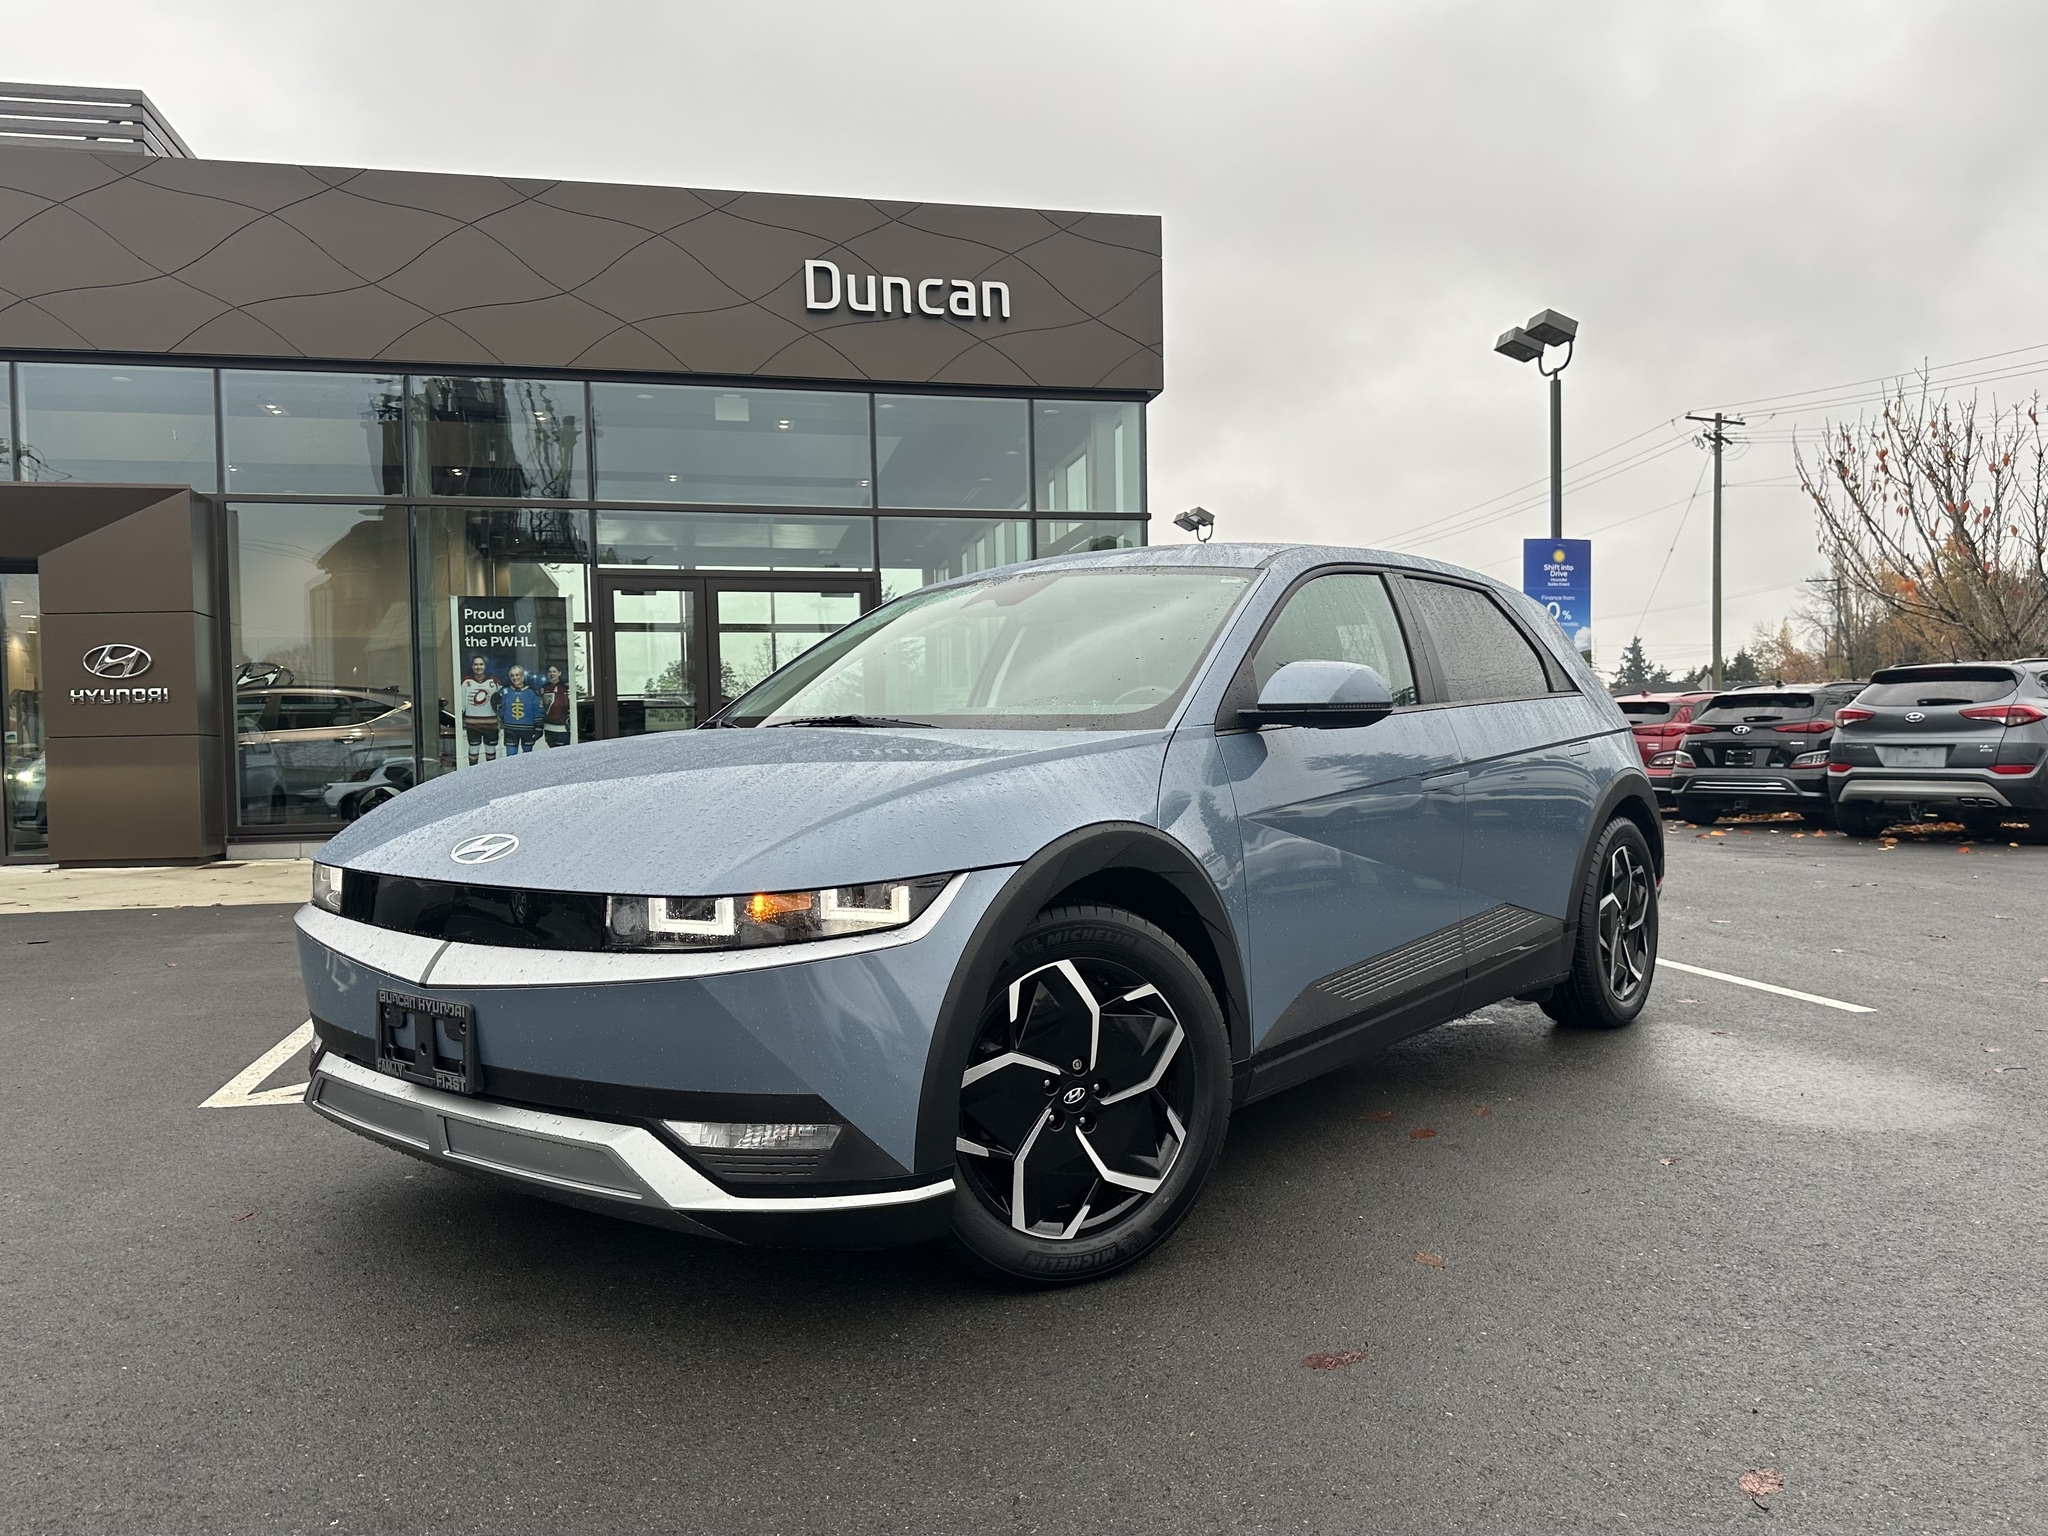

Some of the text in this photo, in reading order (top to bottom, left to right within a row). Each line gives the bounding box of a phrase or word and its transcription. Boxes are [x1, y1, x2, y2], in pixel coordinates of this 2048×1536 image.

[804, 259, 1011, 318] Duncan
[464, 608, 505, 620] Proud
[464, 622, 532, 636] partner of
[464, 636, 537, 647] the PWHL.
[69, 687, 169, 705] HYUNDAI
[1046, 928, 1137, 947] MICHELIN
[379, 990, 466, 1018] DUNCAN HYUNDAI
[1025, 1246, 1118, 1271] MICHELIN
